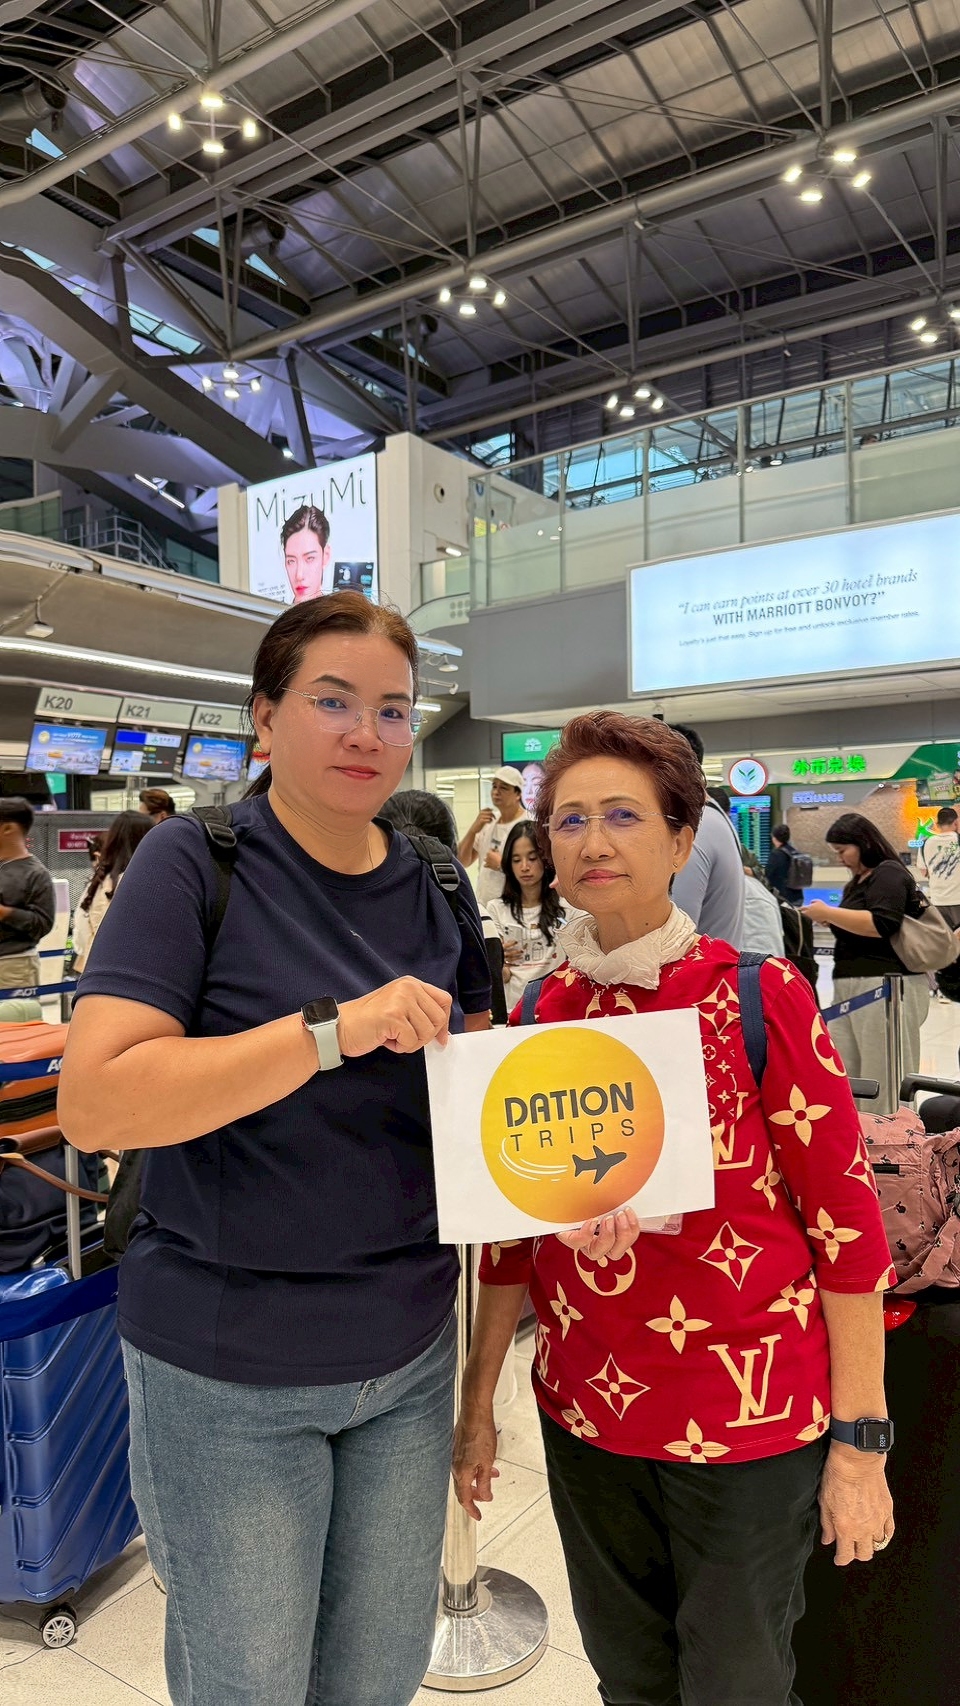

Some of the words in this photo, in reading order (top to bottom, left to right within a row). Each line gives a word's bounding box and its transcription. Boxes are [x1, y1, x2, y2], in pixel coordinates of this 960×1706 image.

[691, 601, 710, 613] can
[713, 599, 738, 610] earn
[740, 592, 775, 609] points
[777, 590, 790, 601] at
[792, 588, 819, 599] over
[822, 580, 840, 595] 30
[842, 574, 873, 592] hotel
[876, 568, 918, 587] brands
[713, 610, 743, 626] WITH
[747, 601, 812, 622] MARRIOTT
[43, 695, 74, 711] K20
[126, 704, 151, 719] K21
[200, 712, 222, 725] K22
[793, 755, 867, 776] 外币兑换
[504, 1082, 635, 1128] DATION
[510, 1118, 635, 1152] TRIPS
